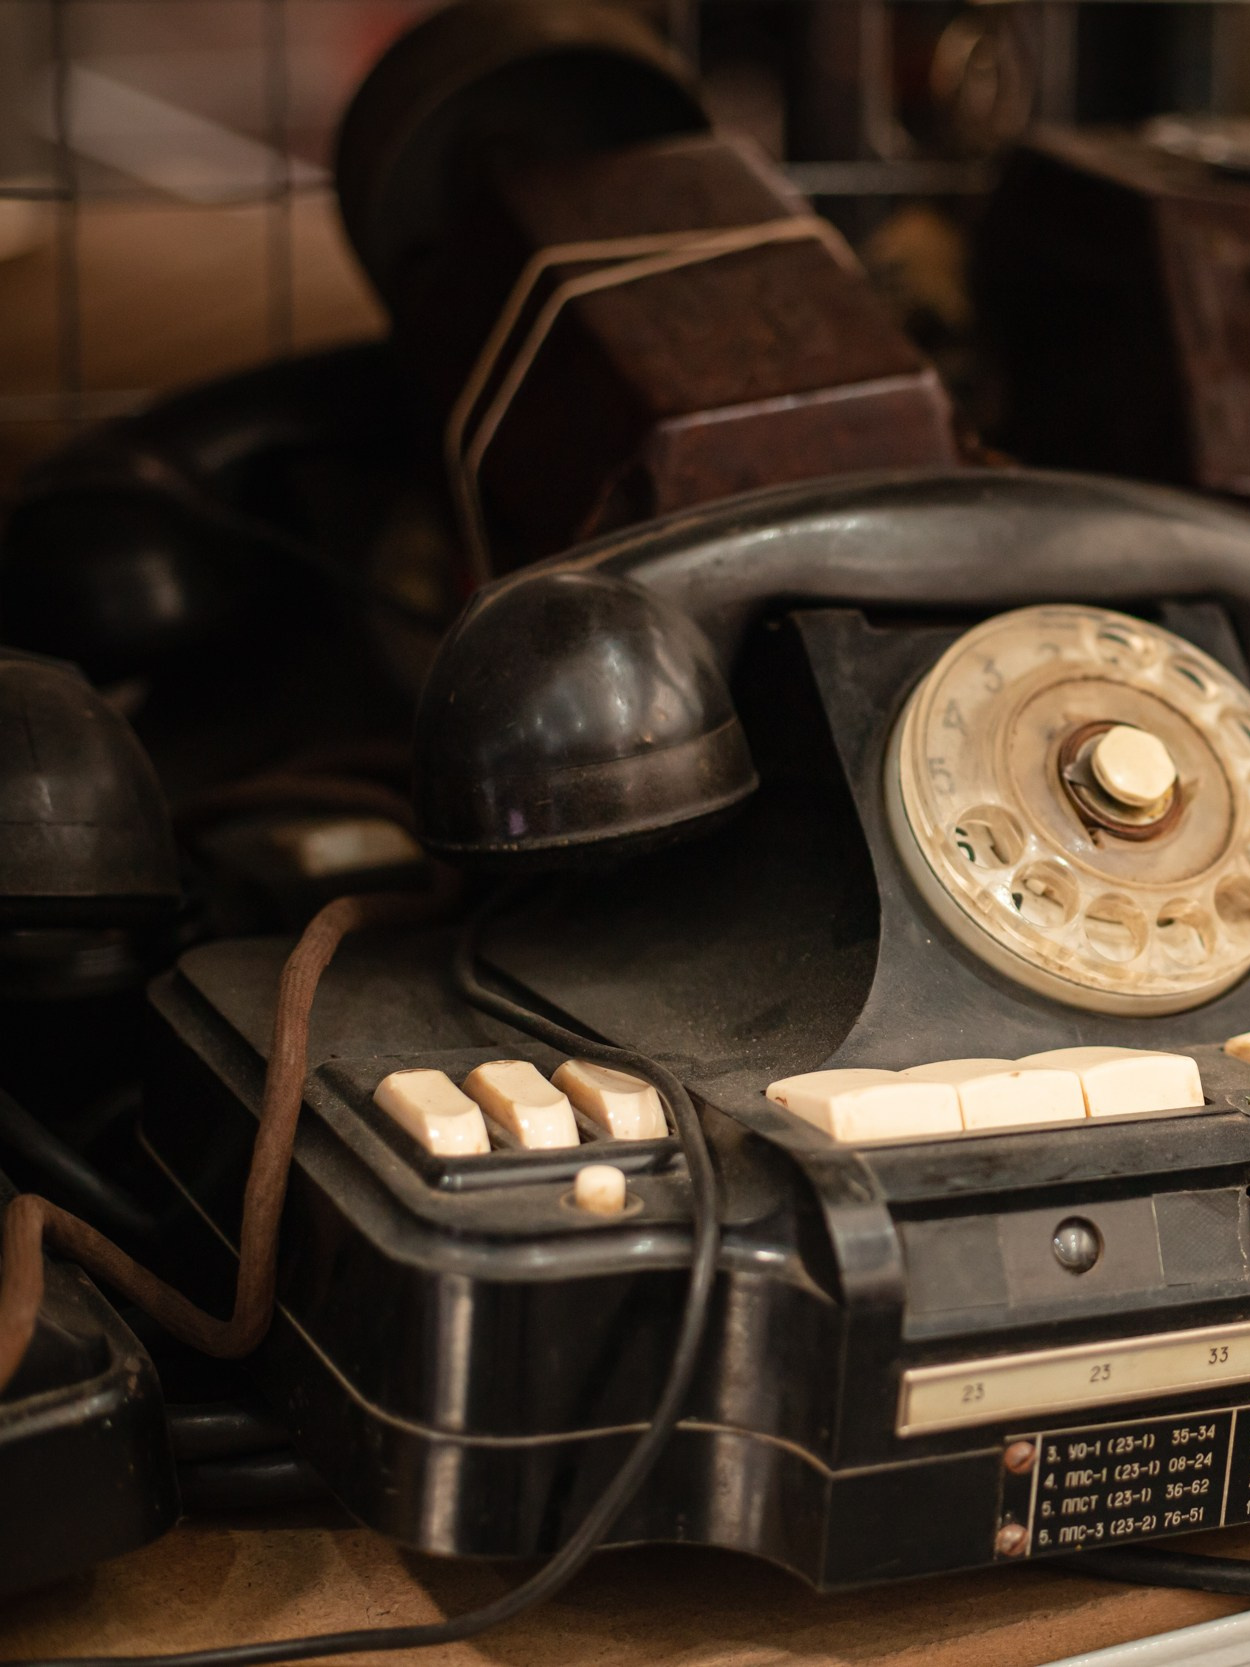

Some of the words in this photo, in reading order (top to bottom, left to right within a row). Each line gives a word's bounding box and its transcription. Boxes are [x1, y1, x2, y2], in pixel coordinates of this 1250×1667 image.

[961, 1383, 985, 1403] 23
[1089, 1364, 1112, 1383] 23
[1208, 1346, 1229, 1365] 33
[1068, 1441, 1101, 1460] УО-1
[1107, 1434, 1156, 1454] (23-1)
[1172, 1424, 1216, 1445] 35-34
[1044, 1473, 1058, 1489] 4.
[1065, 1467, 1107, 1488] ППС-1
[1114, 1460, 1160, 1480] (23-1)
[1168, 1452, 1213, 1473] 08-24
[1061, 1495, 1098, 1515] ППСТ
[1107, 1488, 1152, 1508] (23-1)
[1166, 1479, 1210, 1499] 36-62
[1058, 1522, 1104, 1543] ППС-3
[1110, 1516, 1156, 1535] (23-2)
[1164, 1507, 1204, 1527] 76-51
